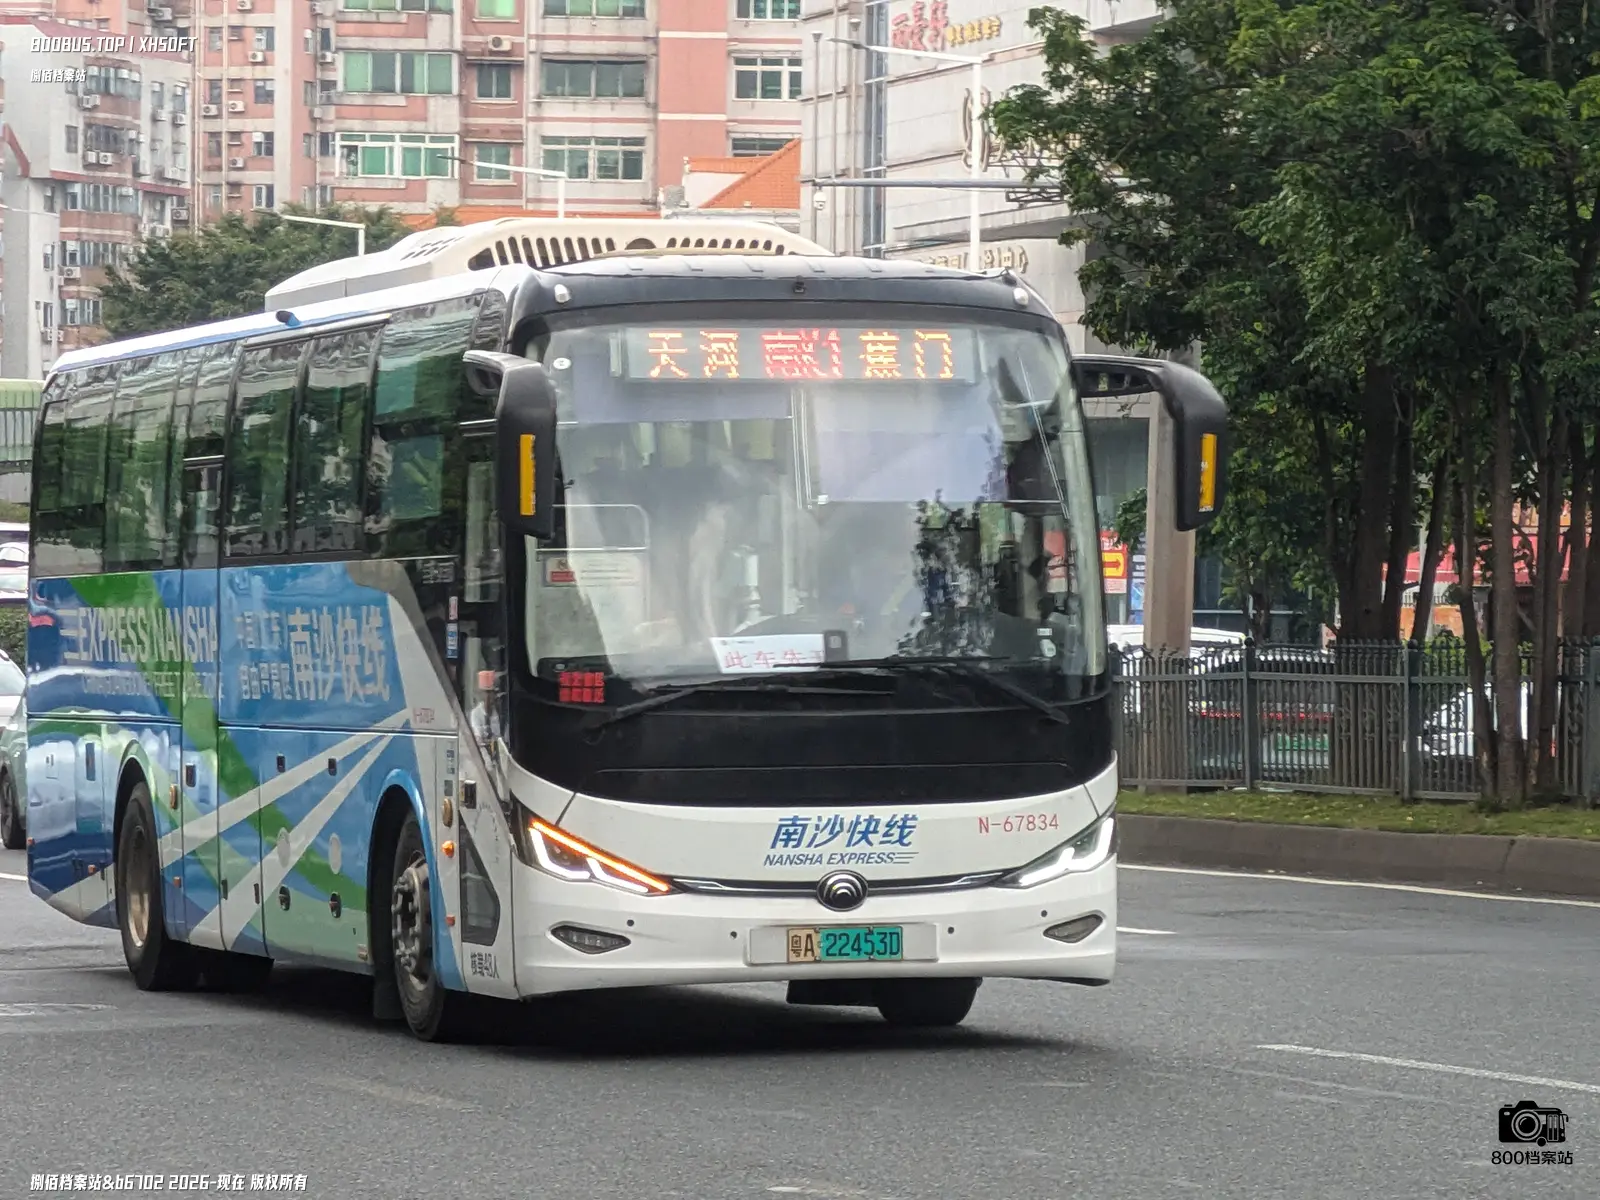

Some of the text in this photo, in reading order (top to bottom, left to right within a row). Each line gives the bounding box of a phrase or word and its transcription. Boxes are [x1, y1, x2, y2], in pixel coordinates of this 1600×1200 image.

[648, 330, 739, 378] 天河
[858, 330, 954, 379] 蕉门
[78, 606, 150, 662] EXPRESS
[288, 605, 390, 703] 南沙快线
[770, 814, 919, 849] 南沙快线
[978, 814, 1059, 834] N-67834
[764, 852, 896, 867] NANSHA EXPRESS
